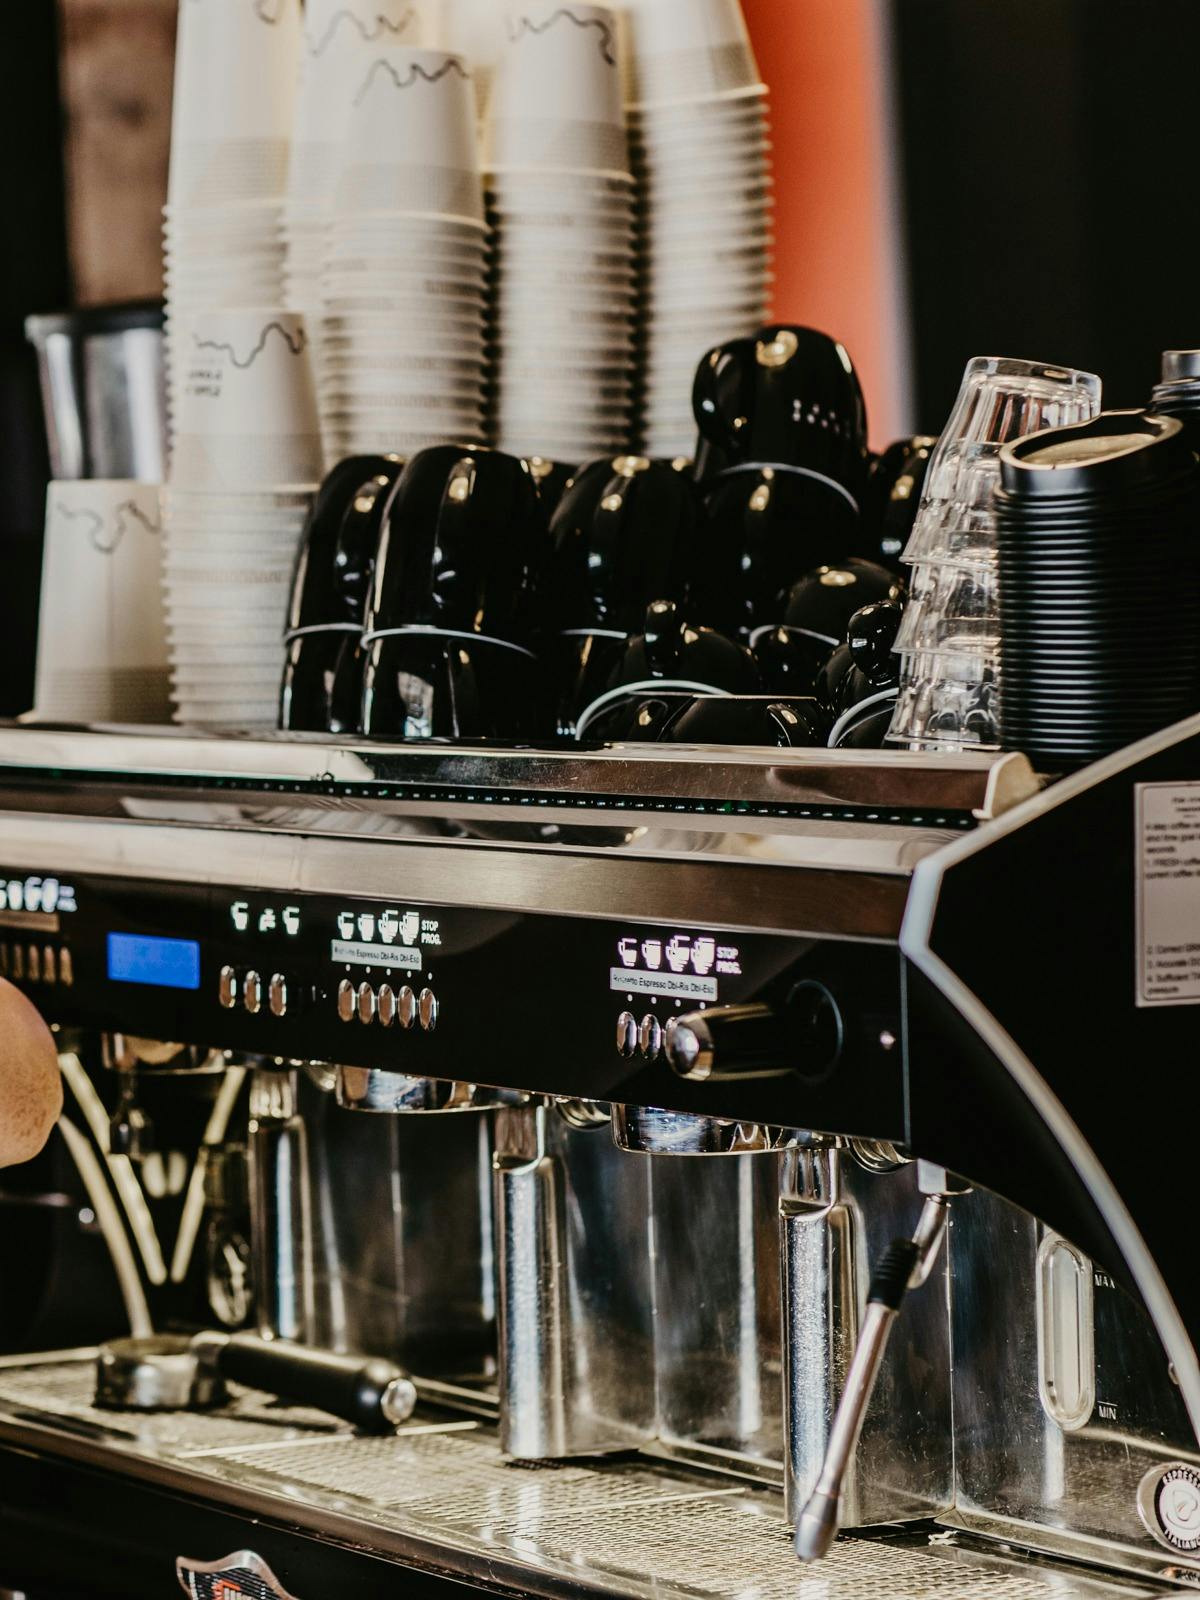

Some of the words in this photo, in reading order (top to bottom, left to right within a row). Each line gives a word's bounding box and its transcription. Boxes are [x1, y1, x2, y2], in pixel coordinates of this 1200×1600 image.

[421, 920, 439, 931] STOP
[421, 932, 442, 945] PROG.
[716, 946, 739, 959] STOP
[639, 977, 666, 990] Espresso
[1094, 1274, 1116, 1289] MAX
[1098, 1405, 1117, 1420] MIN
